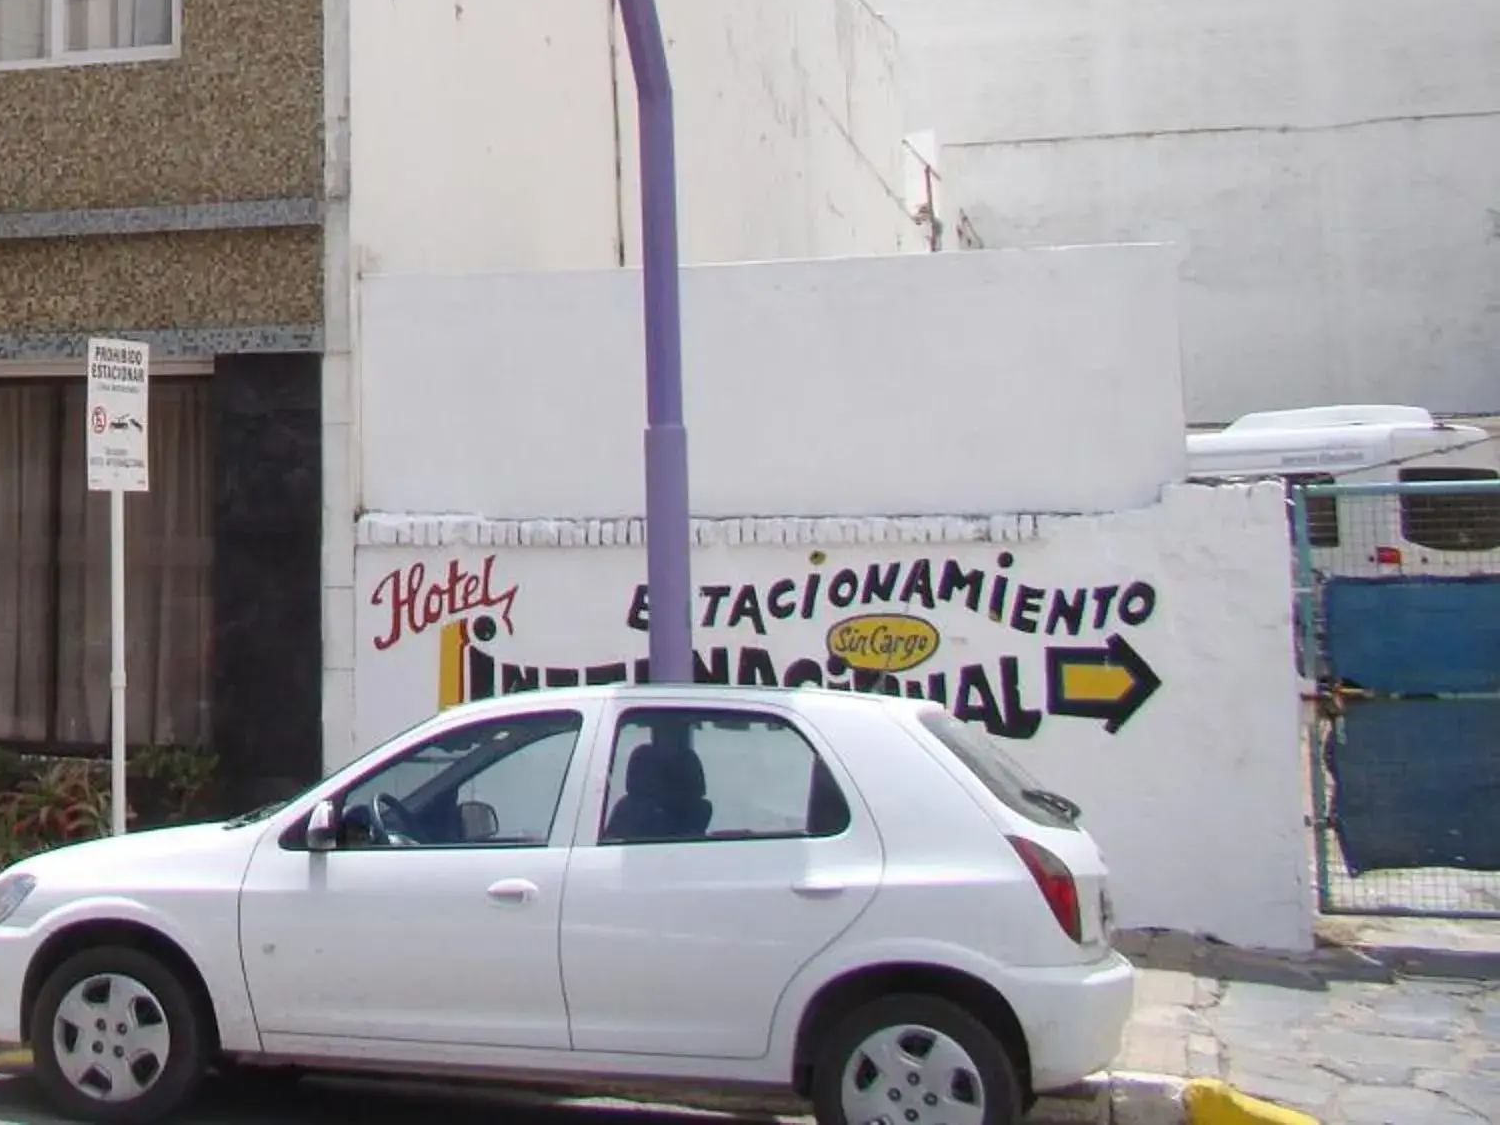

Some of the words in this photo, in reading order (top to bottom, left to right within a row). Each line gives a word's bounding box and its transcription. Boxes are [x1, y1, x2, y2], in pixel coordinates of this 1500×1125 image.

[371, 554, 519, 651] Hotel
[834, 626, 871, 655] Sin
[870, 624, 929, 662] Cargo
